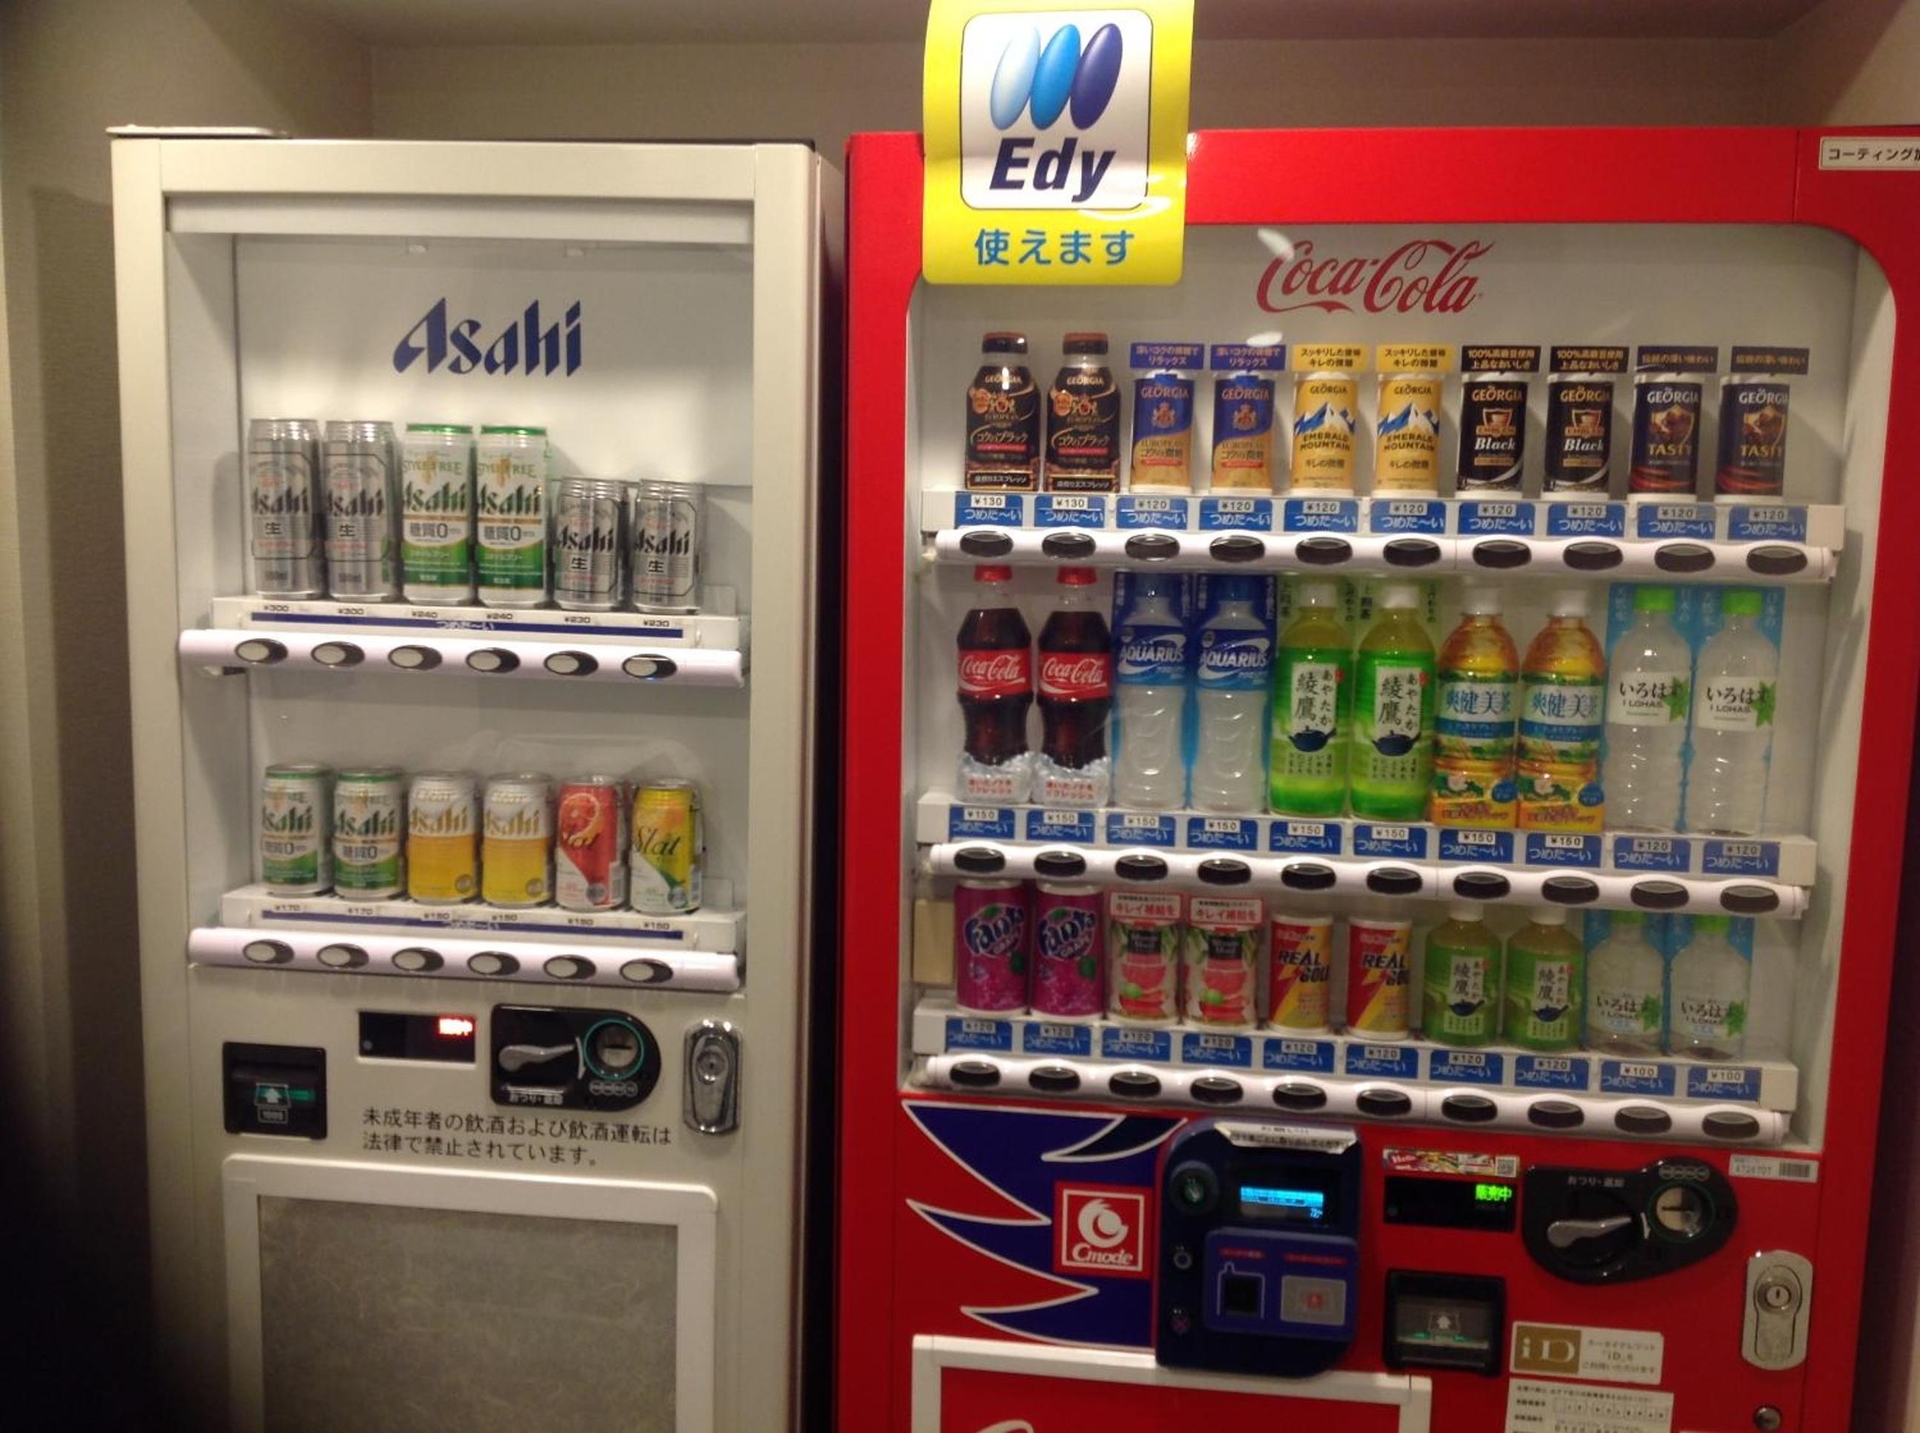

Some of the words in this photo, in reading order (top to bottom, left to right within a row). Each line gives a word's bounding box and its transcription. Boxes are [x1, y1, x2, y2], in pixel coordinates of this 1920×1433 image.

[989, 137, 1116, 203] Edy
[975, 228, 1134, 266] 使えます
[1257, 240, 1496, 313] Coca-Cola
[393, 297, 581, 377] Asahi
[985, 374, 1022, 384] GEOGIA
[1141, 386, 1189, 398] GEORGIA
[1222, 387, 1269, 400] GEORGIA
[1310, 383, 1347, 394] GEORGIA
[1394, 384, 1432, 395] GEORGIA
[1474, 437, 1515, 450] Black
[1564, 439, 1603, 451] Black
[404, 481, 466, 512] Asahi
[478, 484, 541, 515] Asahi
[974, 496, 1003, 507] ¥130
[1056, 498, 1085, 508] ¥130
[1138, 499, 1167, 510] ¥120
[1222, 500, 1251, 511] ¥120
[1307, 502, 1336, 513] ¥120
[1394, 504, 1424, 515] ¥120
[1482, 504, 1513, 516] ¥120
[1572, 505, 1603, 517] ¥120
[1662, 507, 1693, 519] ¥120
[1753, 509, 1784, 521] ¥120
[265, 522, 281, 535] 生
[339, 524, 355, 537] 生
[556, 525, 614, 552] Asahi
[635, 528, 690, 555] Asahi
[571, 557, 588, 570] 生
[648, 560, 664, 573] 生
[1119, 645, 1184, 662] AQUARIUS
[1200, 651, 1268, 668] AQUARIUS
[961, 654, 1022, 681] Coca-Cola
[1042, 657, 1104, 683] Coca-Cola
[1295, 672, 1320, 722] 綾鷹
[1320, 669, 1332, 727] あやたか
[1378, 675, 1403, 725] 綾鷹
[1405, 673, 1418, 730] あやたか
[1446, 690, 1511, 715] 爽健美茶
[1533, 692, 1598, 718] 爽健美茶
[1629, 700, 1664, 708] LOHAS
[967, 809, 995, 820] ¥150
[1047, 813, 1074, 823] ¥150
[1128, 816, 1156, 827] ¥150
[1209, 820, 1236, 830] ¥150
[1293, 824, 1322, 835] ¥150
[1376, 828, 1406, 839] ¥150
[636, 826, 681, 855] Slat
[1463, 832, 1493, 843] ¥150
[1551, 835, 1581, 847] ¥150
[1638, 840, 1668, 851] ¥120
[1727, 844, 1758, 855] ¥120
[964, 906, 1024, 954] Fanta
[1038, 911, 1096, 957] Fanta
[1279, 949, 1321, 965] REAL
[1363, 952, 1405, 969] REAL
[966, 1022, 993, 1032] ¥120
[1044, 1026, 1070, 1037] ¥120
[1123, 1032, 1151, 1042] ¥120
[1204, 1035, 1232, 1047] ¥120
[1286, 1041, 1314, 1052] ¥120
[1367, 1048, 1397, 1059] ¥120
[1452, 1053, 1482, 1064] ¥120
[1538, 1060, 1567, 1070] ¥120
[1625, 1066, 1654, 1077] ¥100
[1712, 1071, 1741, 1081] ¥100
[363, 1108, 672, 1146] 未成年者の飲酒および飲酒運転は
[363, 1132, 597, 1166] 法律で禁止されています。
[1475, 1184, 1512, 1202] 販売中
[1072, 1242, 1134, 1265] Cmode
[1521, 1336, 1576, 1363] iD
